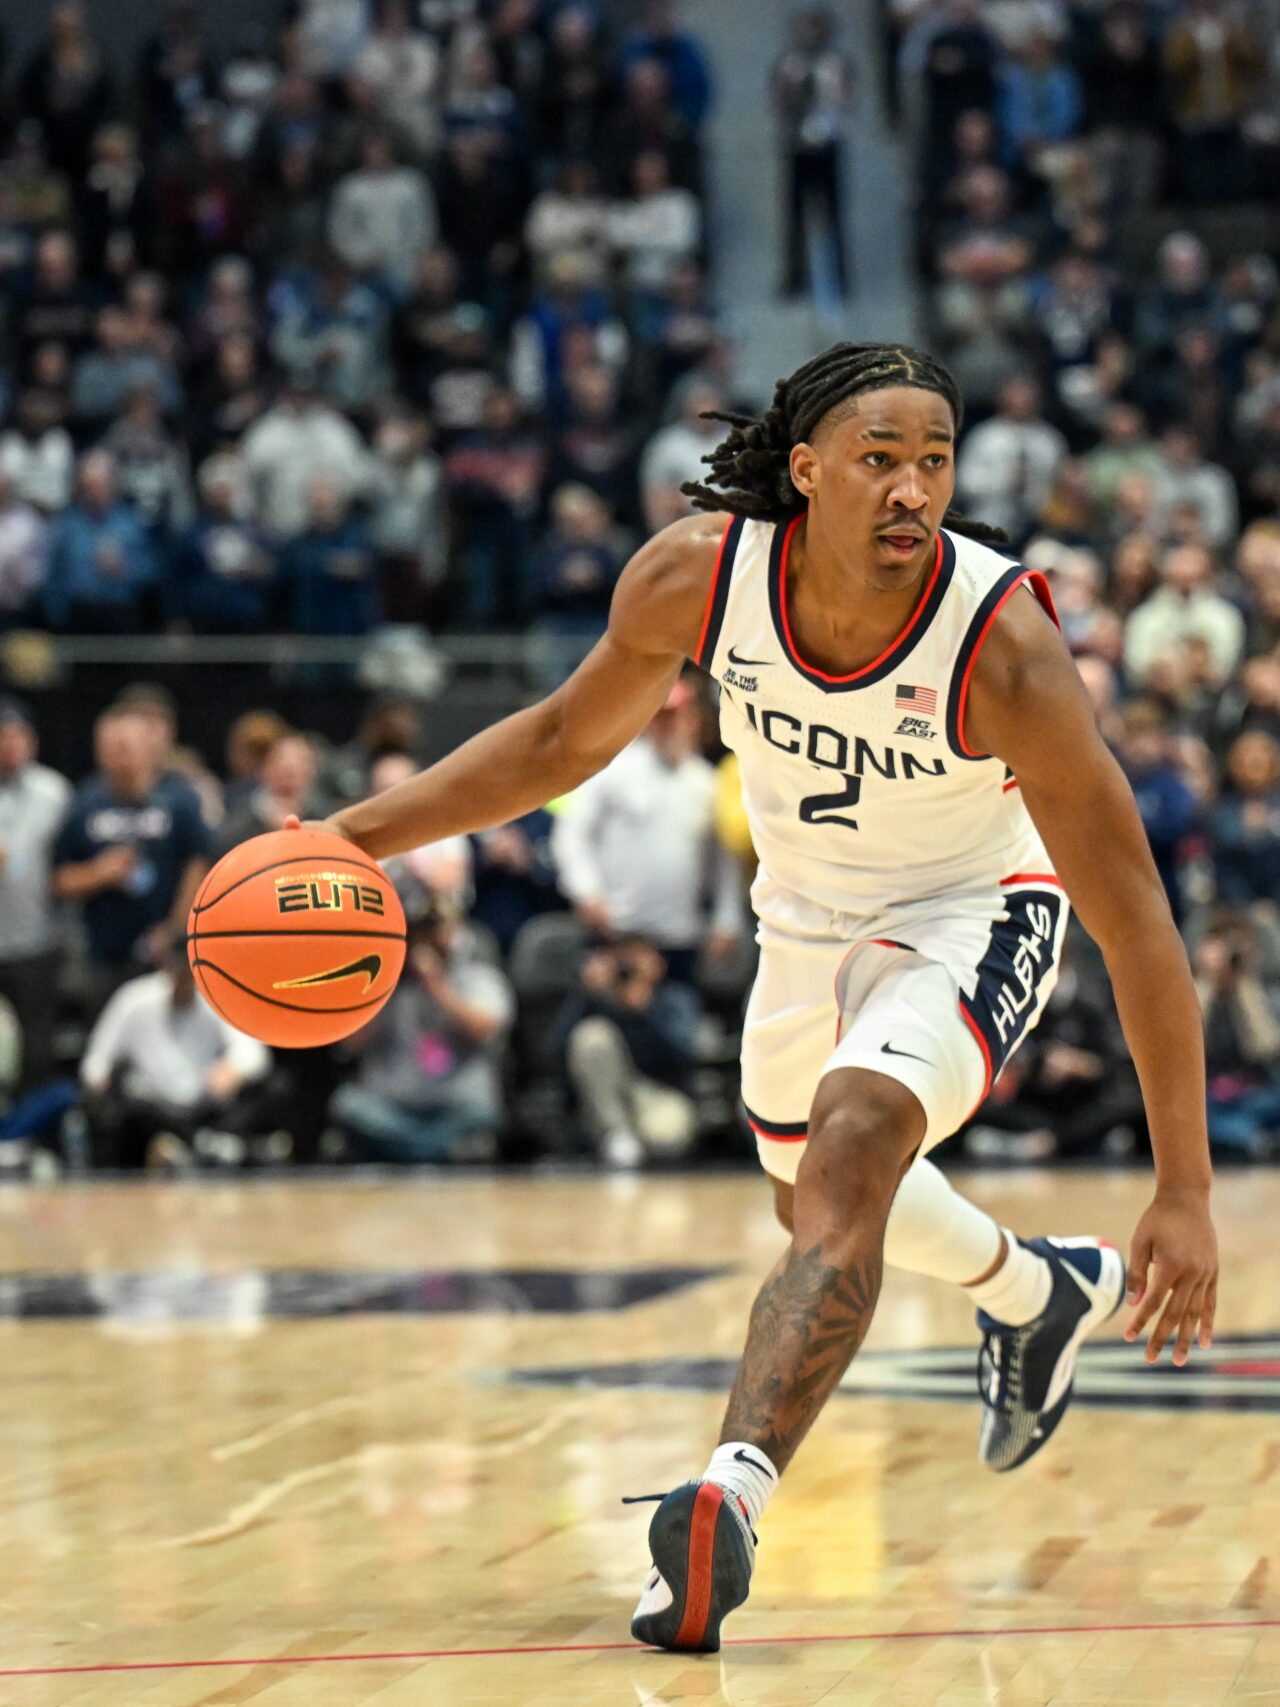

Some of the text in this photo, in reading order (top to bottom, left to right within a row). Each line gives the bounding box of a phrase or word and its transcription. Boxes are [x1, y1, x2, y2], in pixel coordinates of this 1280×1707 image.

[722, 673, 758, 692] CHANGE
[739, 675, 758, 684] THE
[896, 724, 938, 739] EAST
[901, 716, 931, 730] BIG
[798, 766, 862, 832] 2
[276, 881, 385, 917] ELITE
